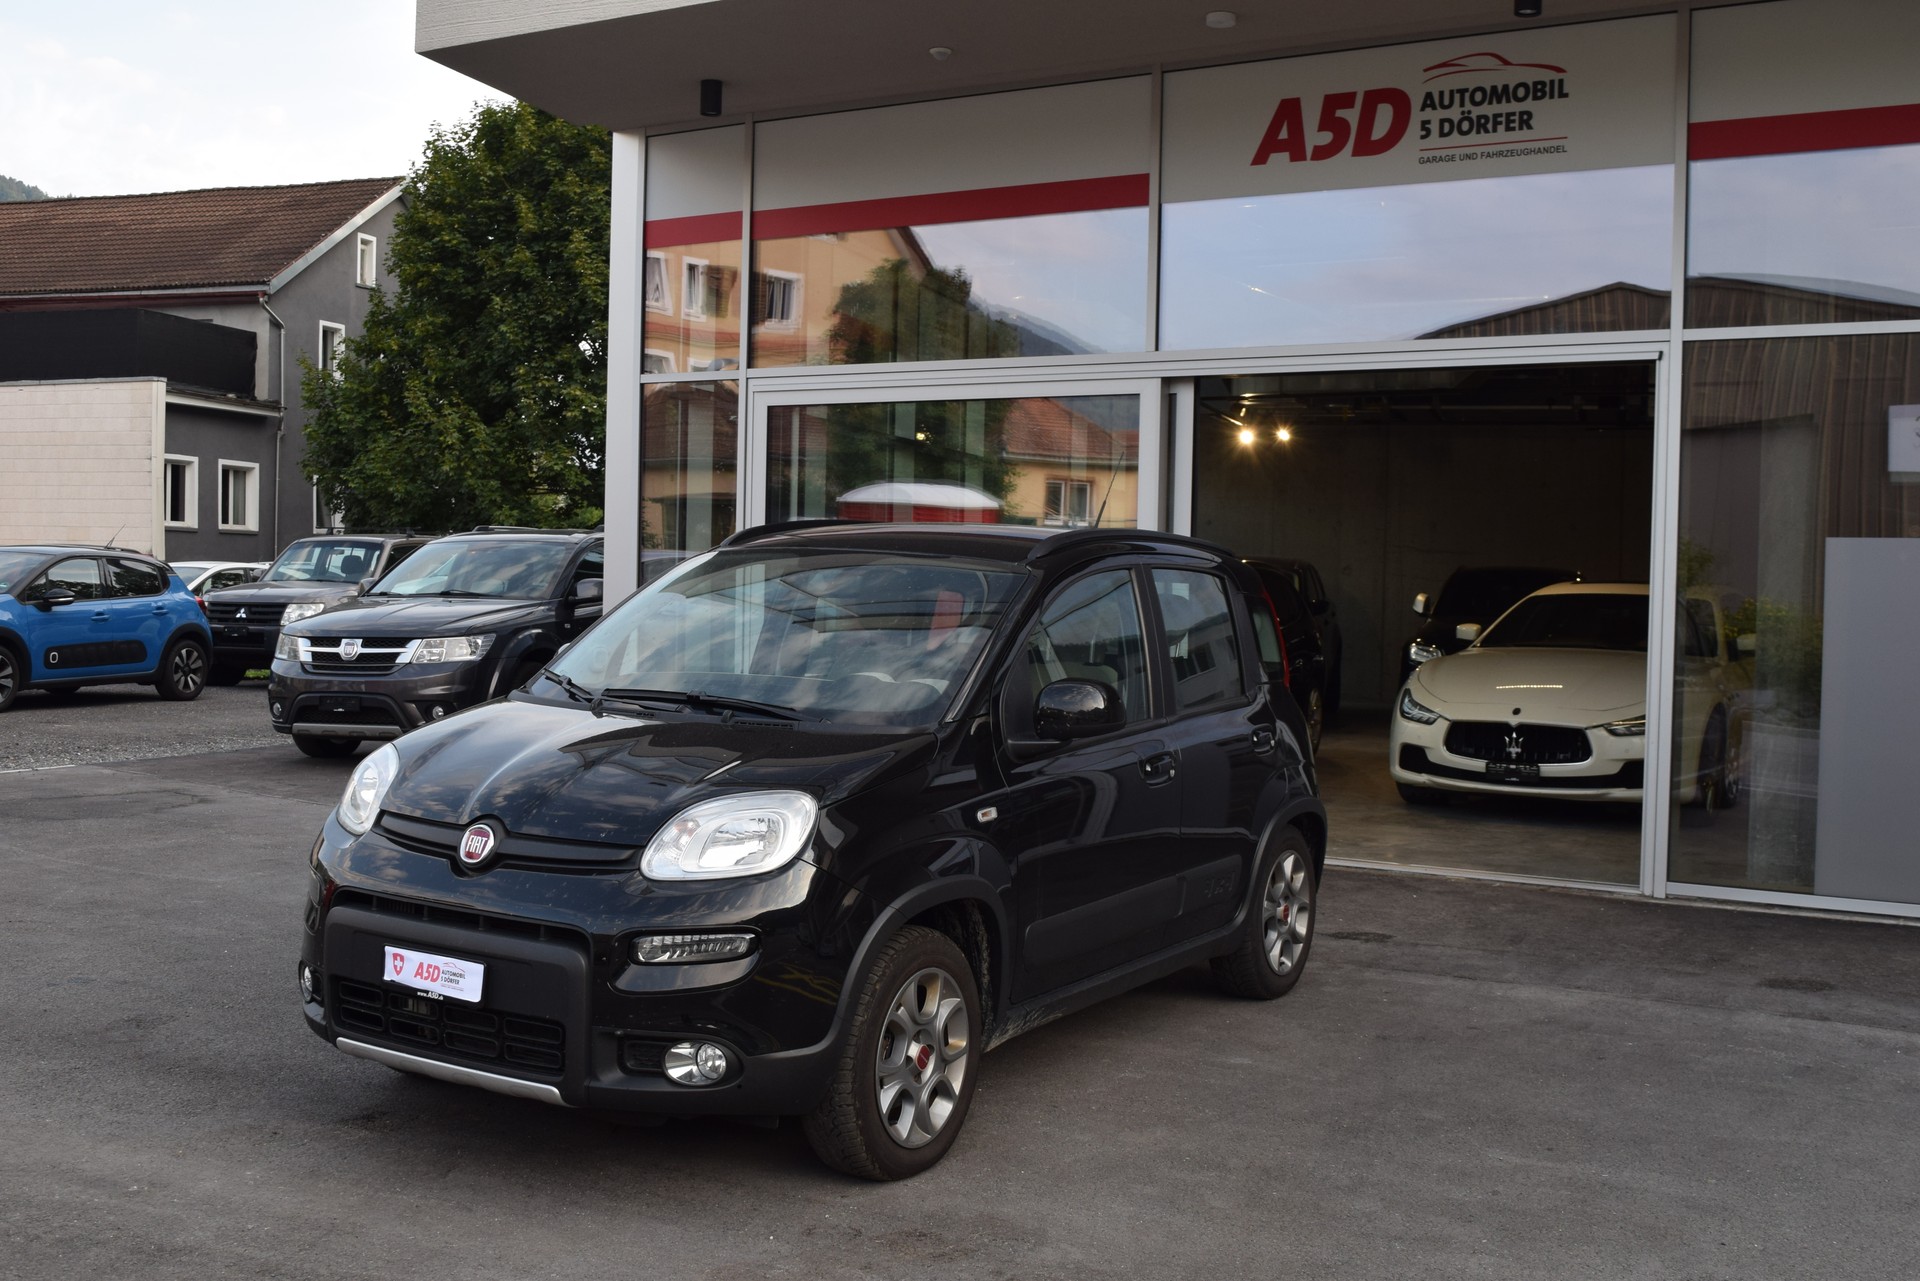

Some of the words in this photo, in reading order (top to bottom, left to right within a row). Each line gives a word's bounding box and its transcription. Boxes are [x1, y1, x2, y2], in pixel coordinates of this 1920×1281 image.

[1419, 78, 1569, 112] AUTOMOBIL
[1250, 87, 1412, 166] A5D
[1420, 119, 1432, 140] 5
[1438, 109, 1534, 139] DÖRFER
[1418, 153, 1457, 165] GARAGE
[1459, 151, 1479, 162] UND
[1480, 145, 1568, 160] FAHRZEUGHANDEL
[466, 835, 488, 854] FIAT
[414, 961, 441, 983] A5D
[441, 969, 466, 980] AUTOMOBIL
[444, 976, 460, 985] DÖRFER
